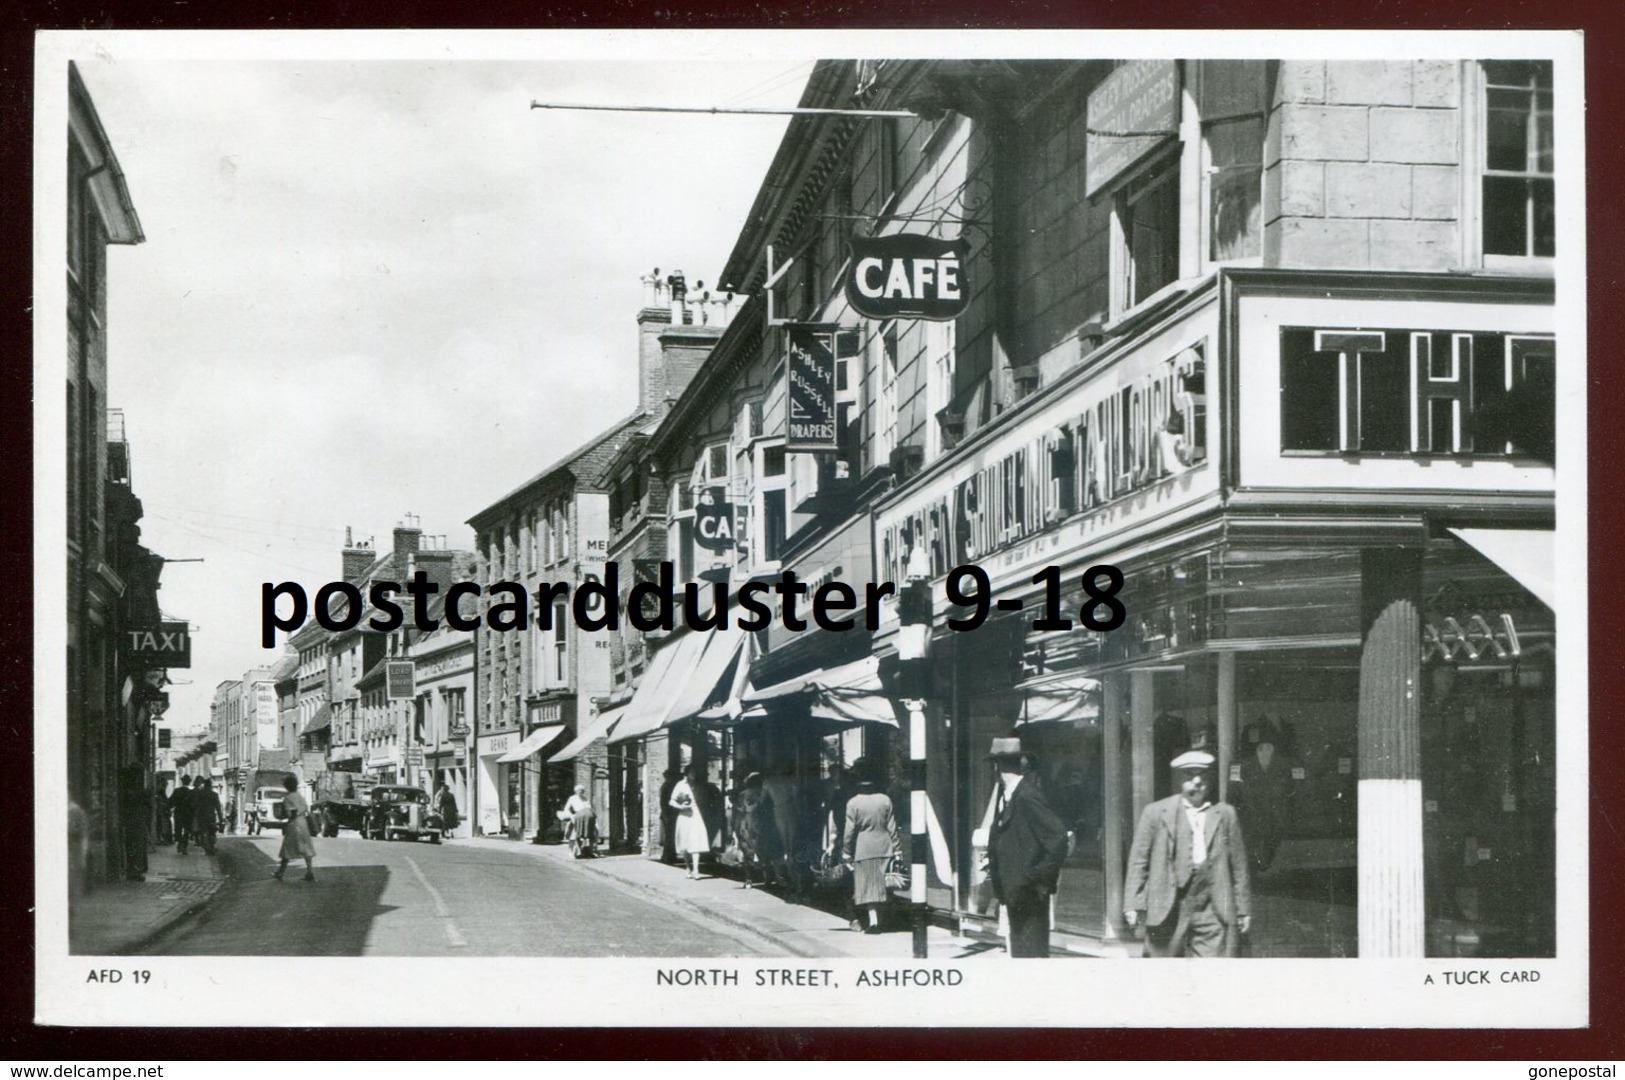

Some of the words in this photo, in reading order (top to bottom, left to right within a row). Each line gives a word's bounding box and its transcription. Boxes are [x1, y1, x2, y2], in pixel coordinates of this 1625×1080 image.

[855, 251, 961, 301] CAFÉ
[790, 341, 832, 384] ASHLEY
[790, 369, 834, 419] RUSSELL
[790, 423, 834, 438] DRAPERS
[1066, 347, 1204, 513] TAILORS
[699, 515, 748, 539] CAF
[128, 632, 185, 652] TAXI
